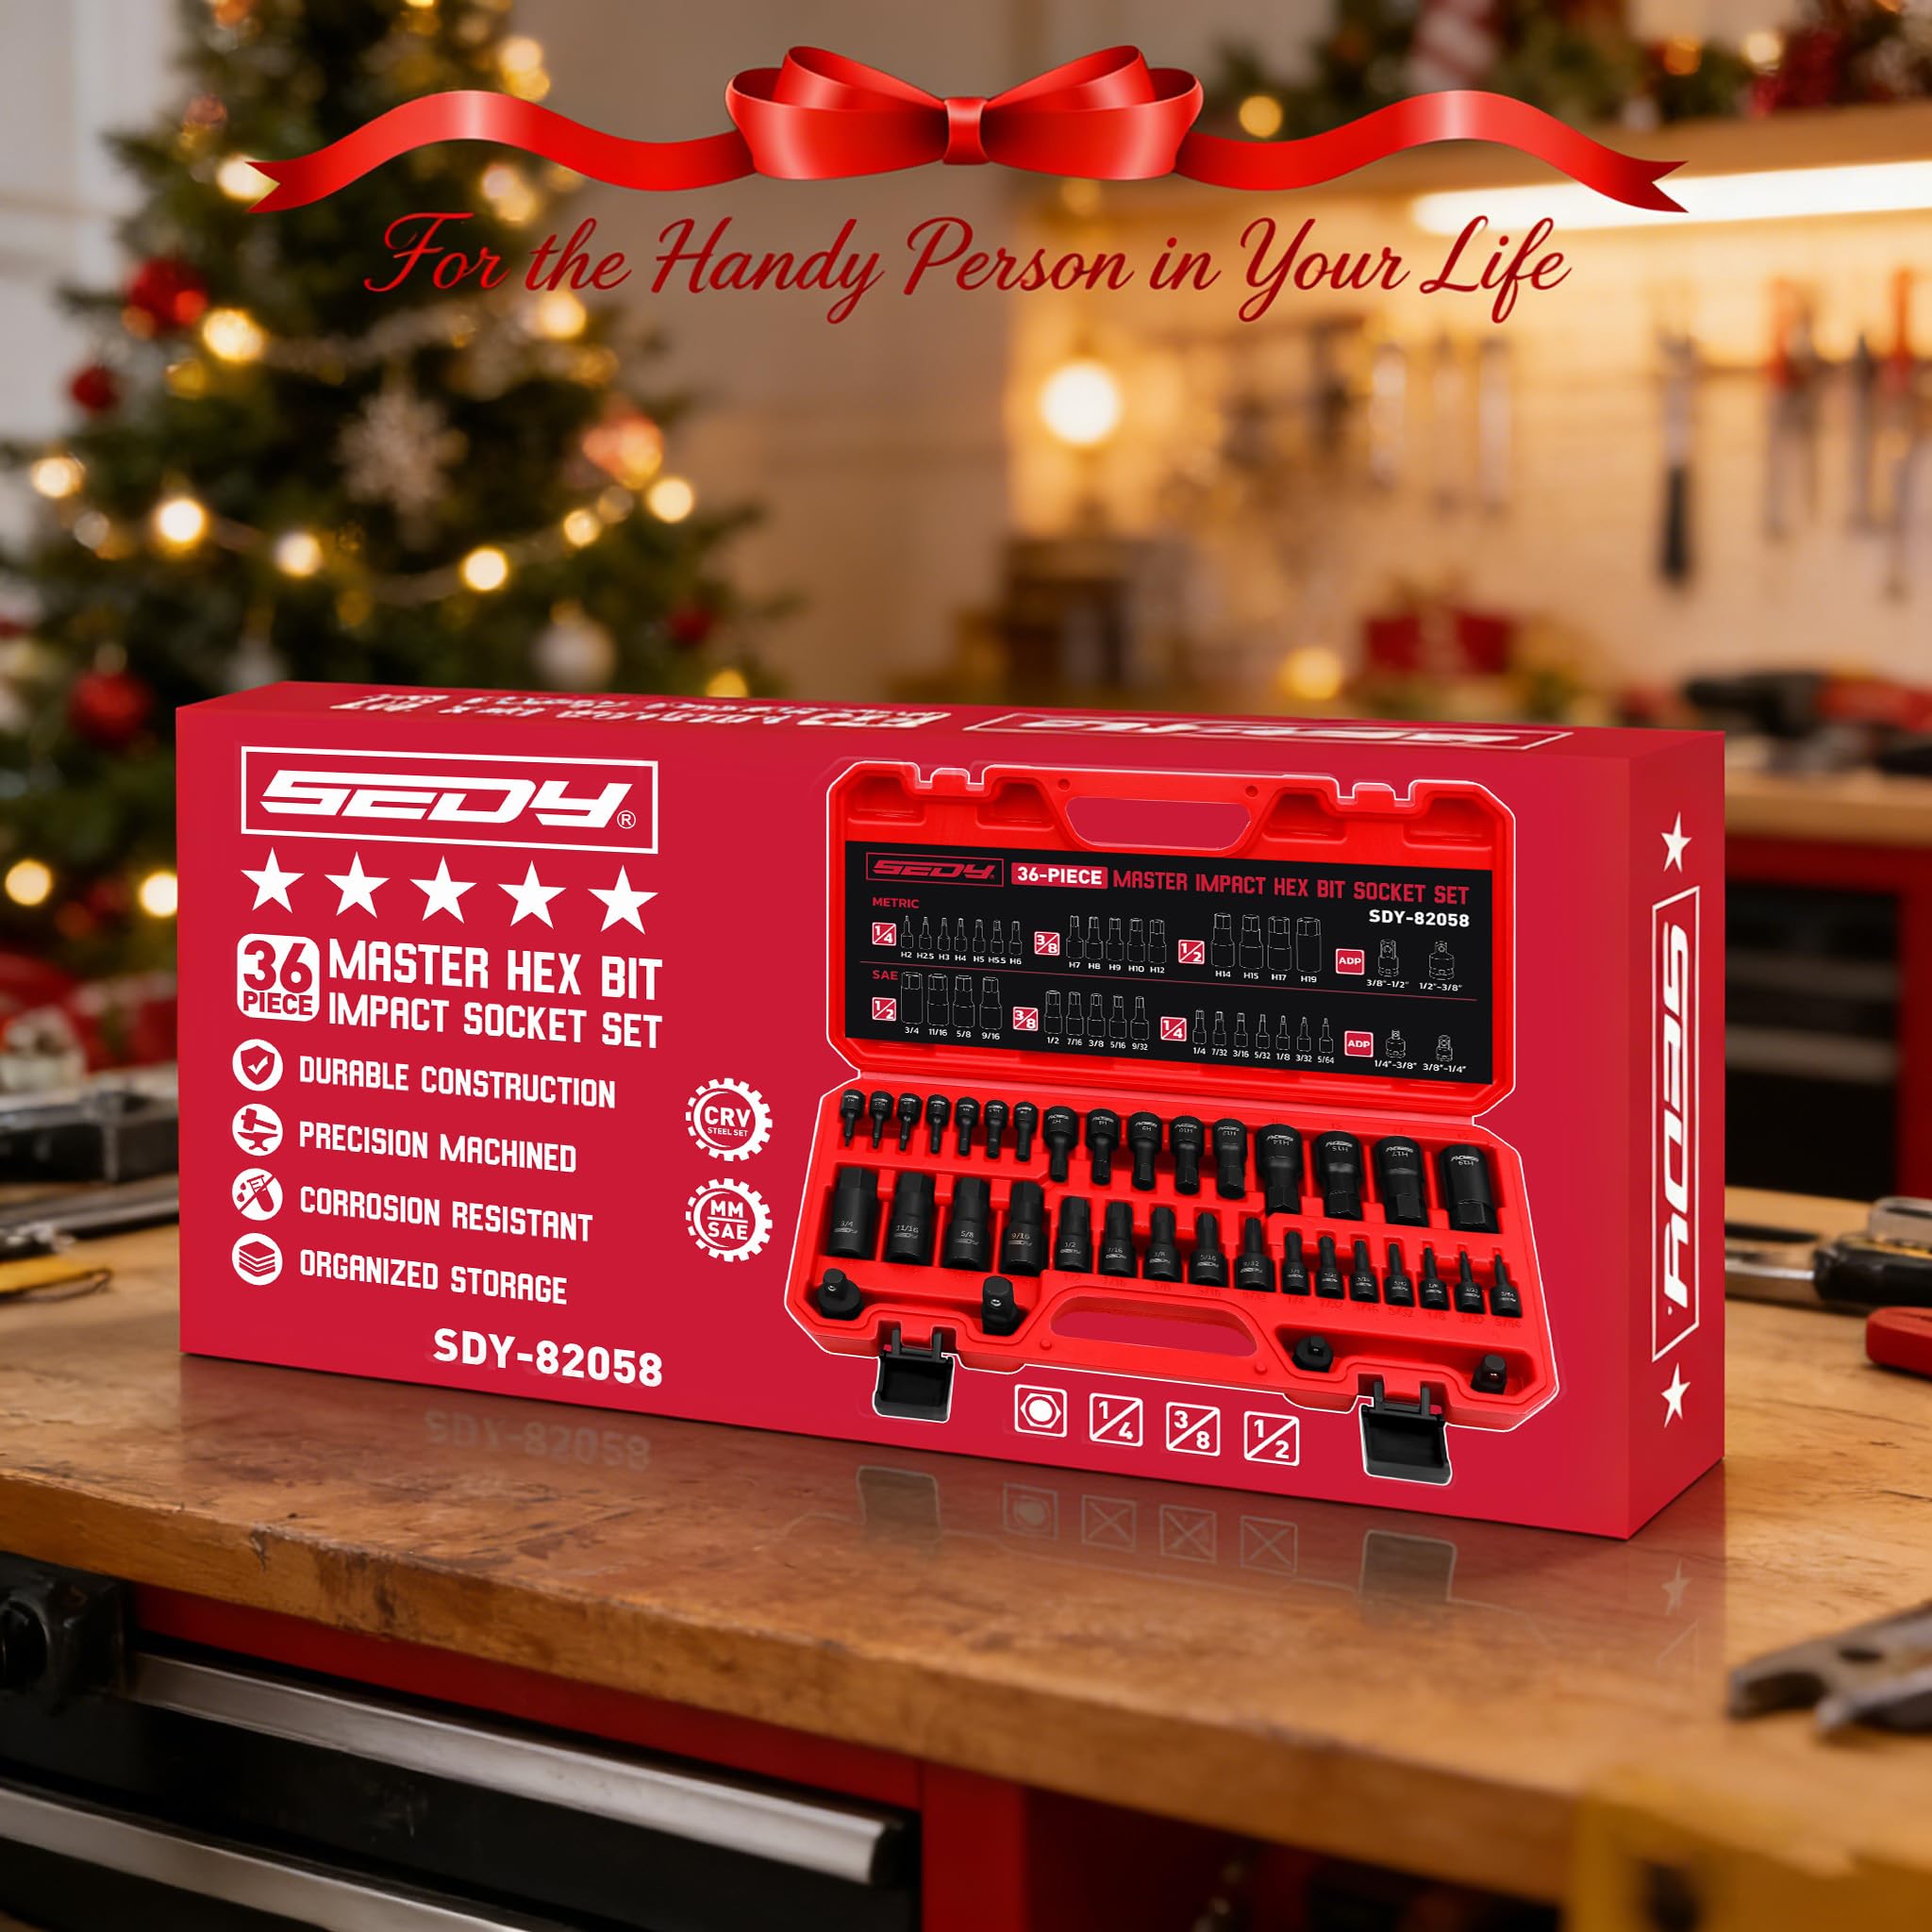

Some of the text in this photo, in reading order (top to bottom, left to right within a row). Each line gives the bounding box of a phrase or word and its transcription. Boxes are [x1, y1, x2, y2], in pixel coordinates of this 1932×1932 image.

[1017, 866, 1470, 905] 36-PIECE MASTER IMPACT HEX BIT SOCKET SET
[872, 897, 920, 908] METRIC
[1369, 909, 1470, 927] SDY-82058
[243, 940, 313, 993] 36
[329, 938, 662, 1000] MASTER HEX BIT
[974, 955, 985, 963] H5
[1009, 957, 1022, 965] H6
[1069, 960, 1081, 969] H7
[1128, 964, 1144, 973] H10
[1150, 965, 1165, 974] H12
[1339, 956, 1361, 966] ADP
[872, 970, 898, 980] SAE
[1243, 972, 1258, 980] H15
[1300, 974, 1317, 983] H19
[242, 991, 313, 1016] PIECE
[329, 991, 663, 1048] IMPACT SOCKET SET
[904, 1026, 1000, 1041] 3/4 11/16 5/8 9/16
[1047, 1037, 1148, 1051] 1/2 7/16 3/8 5/16 9/32
[1347, 1040, 1370, 1049] ADP
[1193, 1047, 1335, 1064] 1/4 7/32 3/16 5/32 1/8 3/32 5/64
[299, 1055, 616, 1108] DURABLE CONSTRUCTION
[705, 1106, 751, 1127] CRV
[708, 1126, 748, 1137] STEEL SET
[299, 1121, 576, 1173] PRECISION MACHINED
[300, 1186, 592, 1242] CORROSION RESISTANT
[710, 1200, 743, 1218] MM
[708, 1222, 748, 1241] SAE
[300, 1249, 567, 1305] ORGANIZED STORAGE
[433, 1327, 663, 1388] SDY-82058
